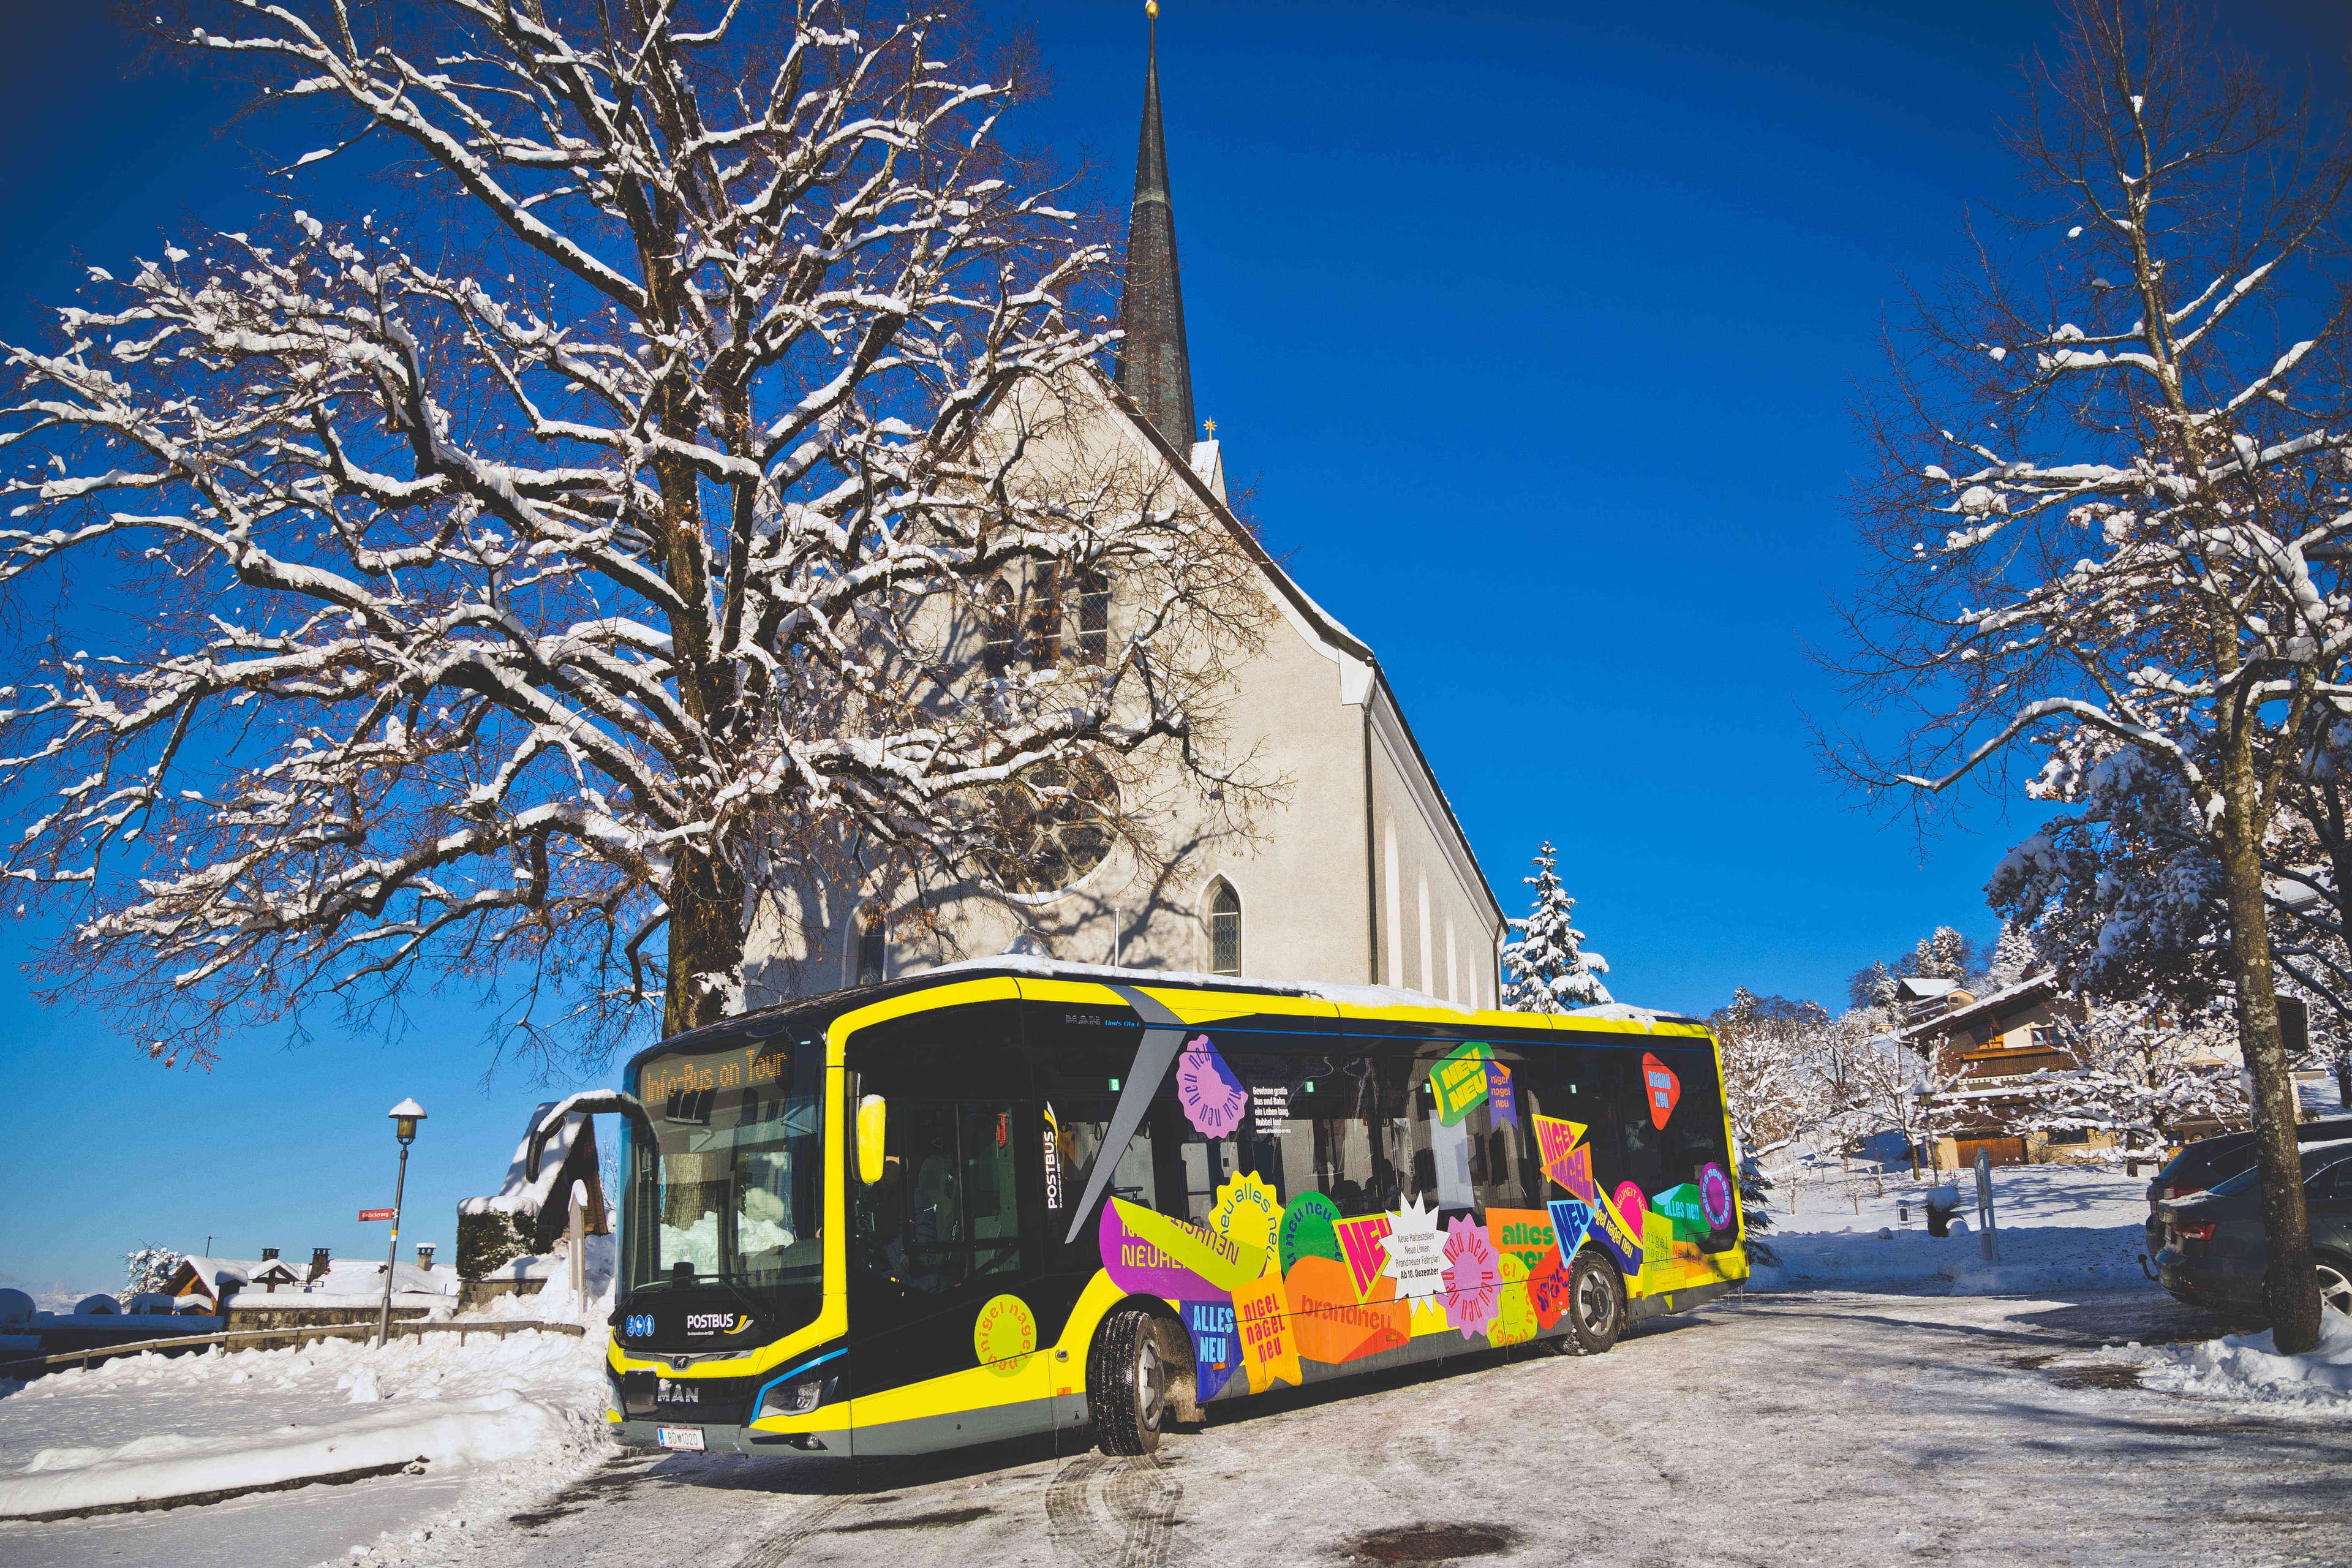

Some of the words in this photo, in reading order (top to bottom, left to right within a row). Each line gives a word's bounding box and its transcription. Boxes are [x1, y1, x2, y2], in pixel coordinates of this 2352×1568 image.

[1066, 1014, 1101, 1025] MAN
[1188, 1042, 1210, 1071] neu
[1441, 1047, 1481, 1090] NEU
[647, 1063, 714, 1102] Info-Bus
[719, 1063, 740, 1087] on
[746, 1049, 788, 1082] Tour
[1184, 1073, 1201, 1106] neu
[1253, 1086, 1273, 1095] Gewinne
[1274, 1086, 1287, 1096] gratis
[1448, 1069, 1488, 1113] NEU
[1491, 1087, 1511, 1097] nagel
[1655, 1091, 1669, 1108] neu
[1536, 1120, 1575, 1164] NIGEL
[1044, 1131, 1058, 1209] POSTBUS
[1551, 1149, 1592, 1204] NAGEL
[1234, 1183, 1271, 1213] alles
[1305, 1202, 1332, 1223] neu
[1686, 1203, 1700, 1221] neu
[1286, 1207, 1303, 1246] neu
[1397, 1234, 1409, 1243] Neue
[1409, 1232, 1434, 1242] Haltestellen
[1502, 1222, 1555, 1246] alles
[1551, 1203, 1589, 1260] NEU
[1594, 1205, 1608, 1228] igel
[1605, 1219, 1623, 1246] nagel
[1621, 1237, 1634, 1259] neu
[1338, 1218, 1393, 1297] NEU
[1395, 1258, 1421, 1268] Brandneuer
[1422, 1256, 1441, 1267] Fahrplan
[1417, 1245, 1430, 1253] Linien
[1444, 1232, 1464, 1265] neu
[1468, 1232, 1488, 1264] neu
[1401, 1271, 1408, 1280] Ab
[1415, 1268, 1439, 1278] Dezember
[687, 1313, 734, 1329] POSTBUS
[1193, 1305, 1234, 1333] ALLES
[1302, 1294, 1392, 1330] brandneu
[979, 1302, 1004, 1352] nigel
[1009, 1303, 1032, 1359] nagel
[987, 1353, 1018, 1371] neu
[1200, 1336, 1226, 1362] NEU
[1258, 1336, 1282, 1363] neu
[657, 1386, 699, 1403] MAN
